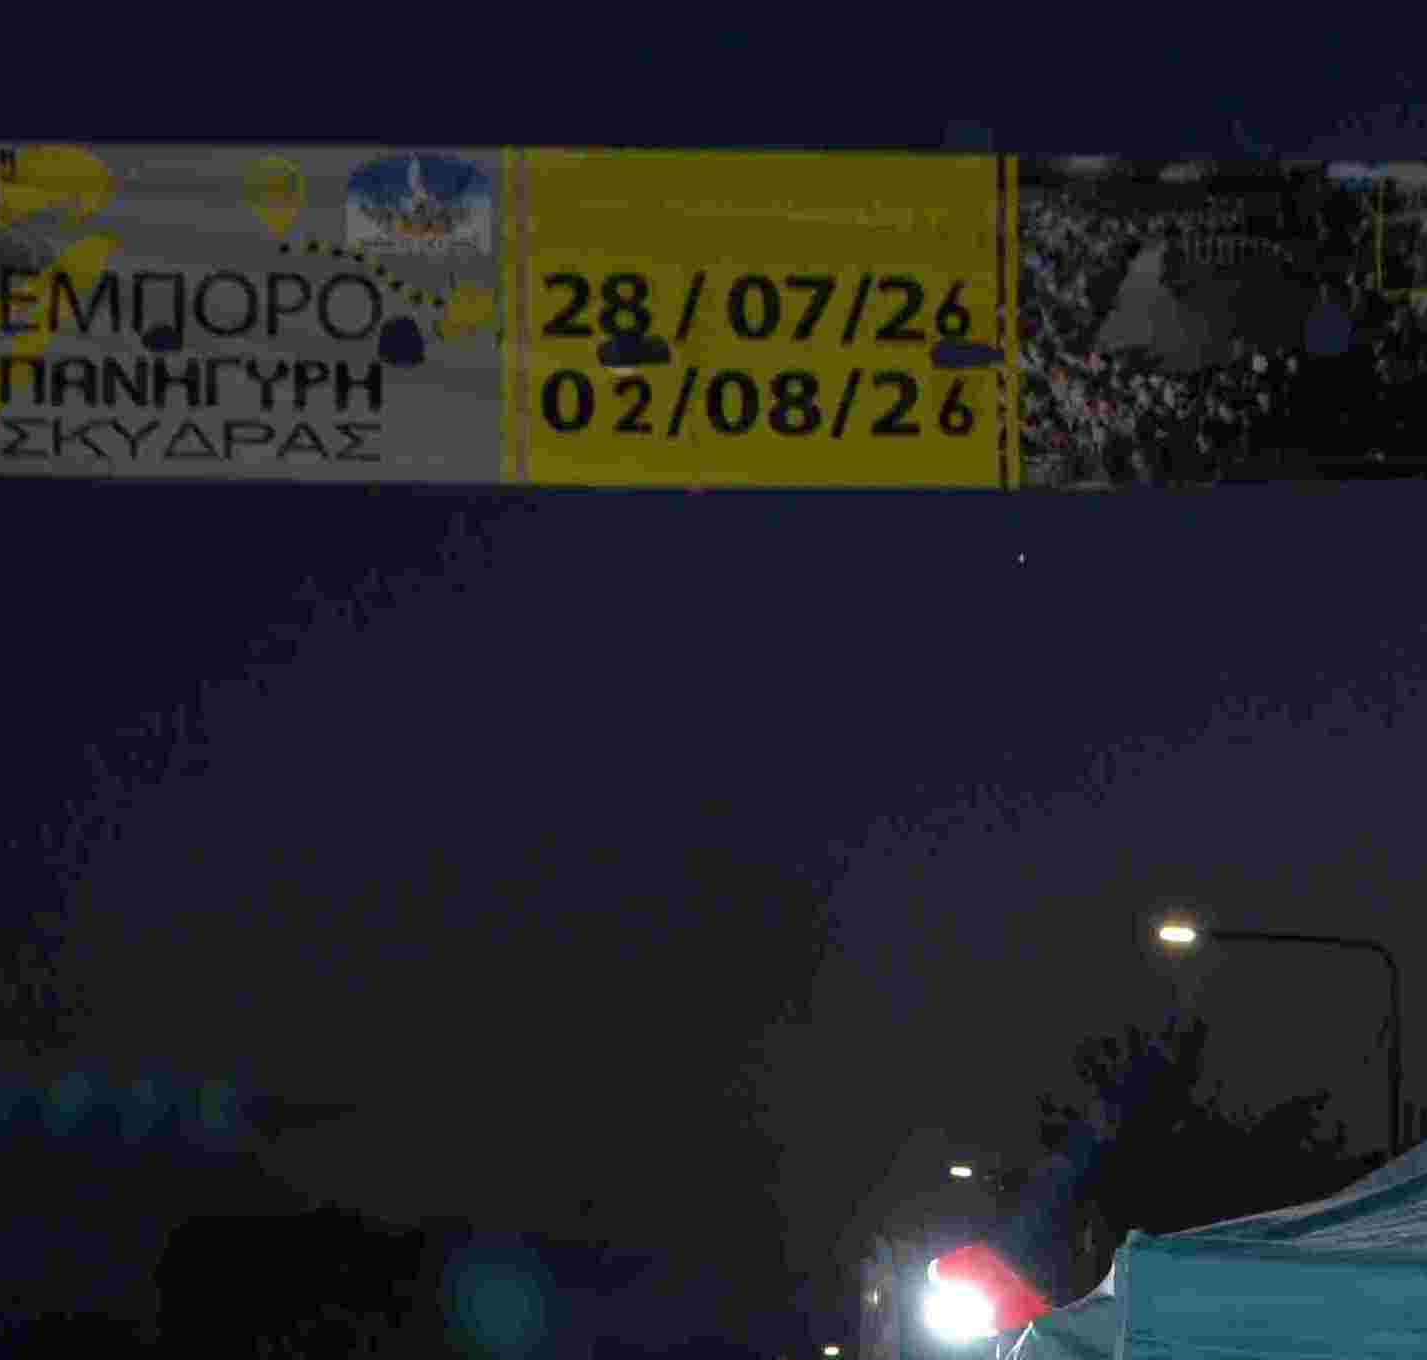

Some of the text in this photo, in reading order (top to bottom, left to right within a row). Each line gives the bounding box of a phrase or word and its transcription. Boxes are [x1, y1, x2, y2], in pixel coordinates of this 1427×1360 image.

[1, 270, 383, 340] ΕΜΠΟΡΟ
[0, 355, 383, 411] ΠΑΝΗΓΥΡΗ
[0, 416, 383, 462] ΣΚΥΔΡΑΣ
